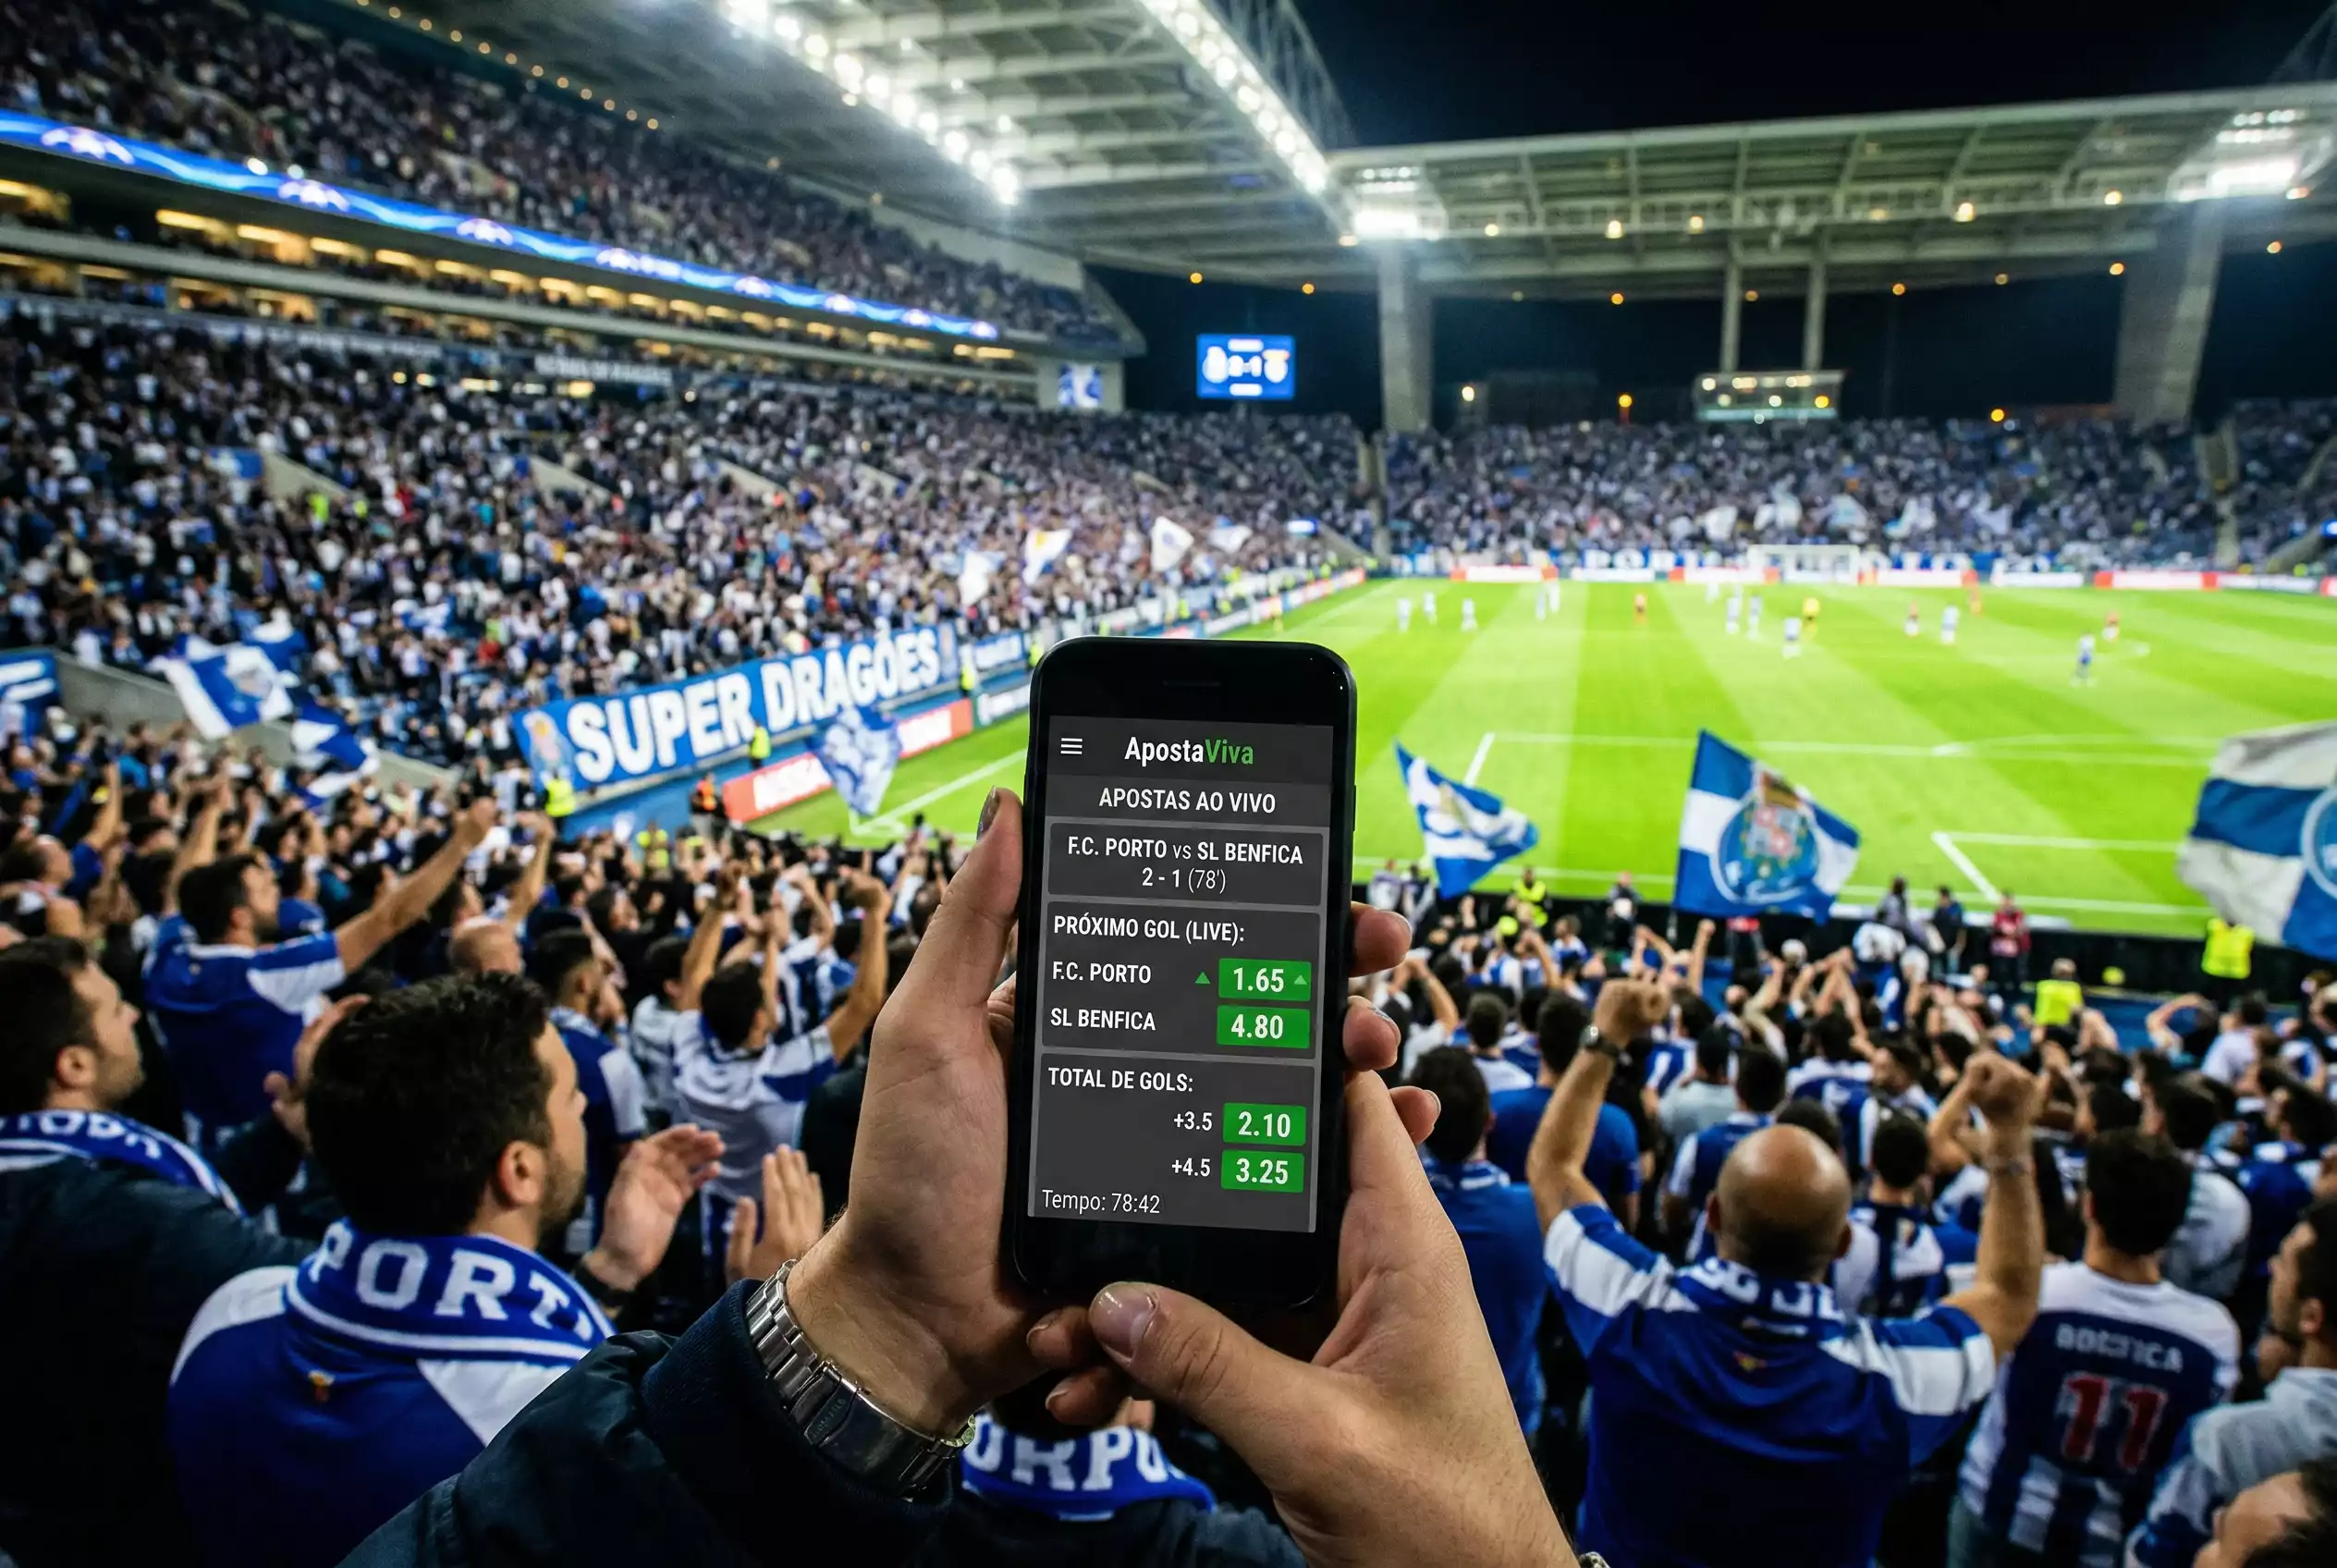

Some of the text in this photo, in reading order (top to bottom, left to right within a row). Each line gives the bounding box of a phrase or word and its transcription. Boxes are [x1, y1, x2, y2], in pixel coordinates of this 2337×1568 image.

[567, 672, 758, 784] SUPER
[1124, 736, 1254, 767] ApostaViva
[1098, 787, 1276, 814] APOSTAS AO VIVO
[1068, 836, 1303, 864] F.C. PORTO vs SL BENFICA
[1142, 866, 1154, 887] 2
[1171, 868, 1181, 888] 1
[1188, 867, 1226, 894] (78')
[1054, 912, 1245, 947] PRÓXIMO GOL (LIVE):
[1052, 961, 1285, 993] F.C. PORTO 1.65
[1050, 1007, 1284, 1040] SL BENFICA 4.80
[1047, 1067, 1193, 1093] TOTAL DE GOLS:
[1173, 1110, 1291, 1138] +3.5 2.10
[1171, 1157, 1289, 1185] +4.5 3.25
[1041, 1189, 1160, 1215] Tempo: 78:42
[2060, 1371, 2168, 1474] 11
